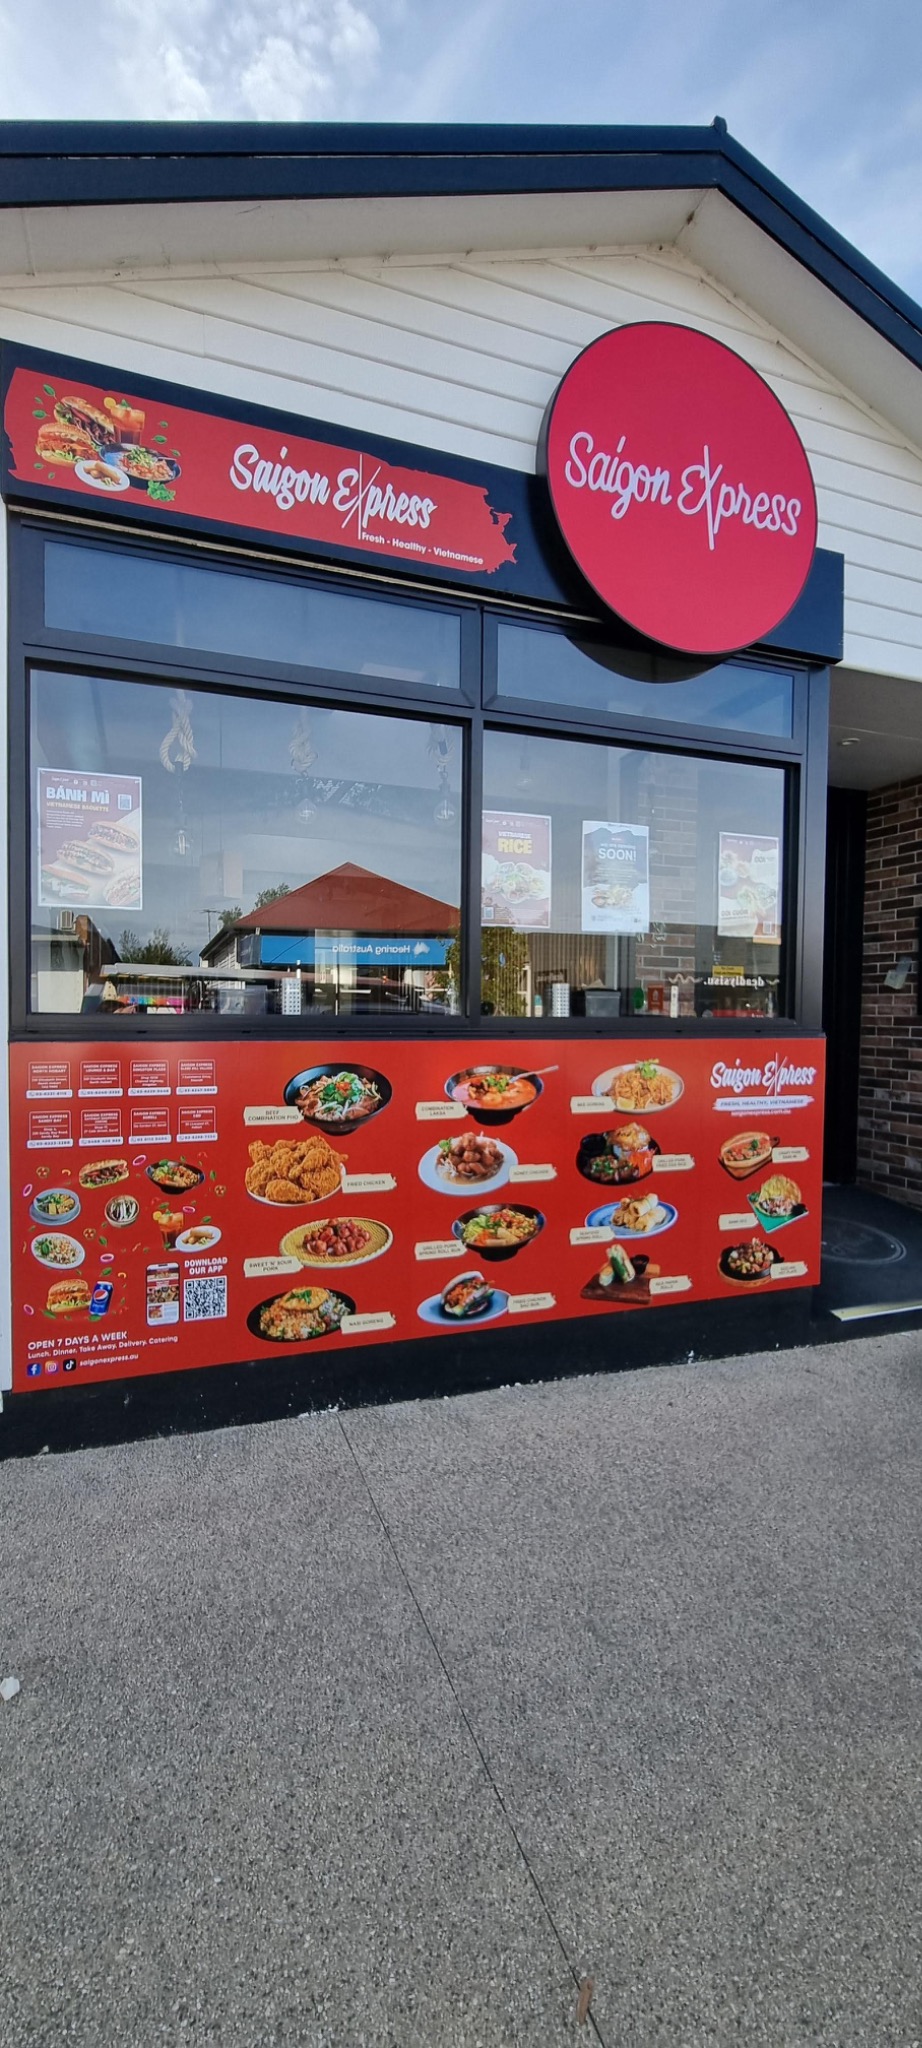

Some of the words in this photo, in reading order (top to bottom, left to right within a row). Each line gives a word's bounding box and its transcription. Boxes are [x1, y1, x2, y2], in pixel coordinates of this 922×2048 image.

[230, 444, 331, 510] Saigon
[332, 454, 438, 540] Express
[677, 444, 801, 551] Express
[362, 532, 385, 545] Fresh
[392, 538, 427, 554] Healthy
[433, 547, 484, 565] Vietnamese
[46, 785, 87, 802] BÁNH
[498, 838, 532, 854] RICE
[598, 848, 636, 861] SOON!
[710, 1058, 762, 1093] Saigon
[762, 1052, 817, 1096] Express
[184, 1257, 228, 1268] DOWNLOAD
[208, 1265, 223, 1273] APP
[28, 1340, 55, 1350] OPEN
[57, 1338, 63, 1348] 7
[65, 1336, 89, 1346] DAYS
[92, 1335, 99, 1343] A
[101, 1331, 128, 1342] WEEK
[79, 1345, 96, 1353] Take
[149, 1335, 178, 1345] Catering
